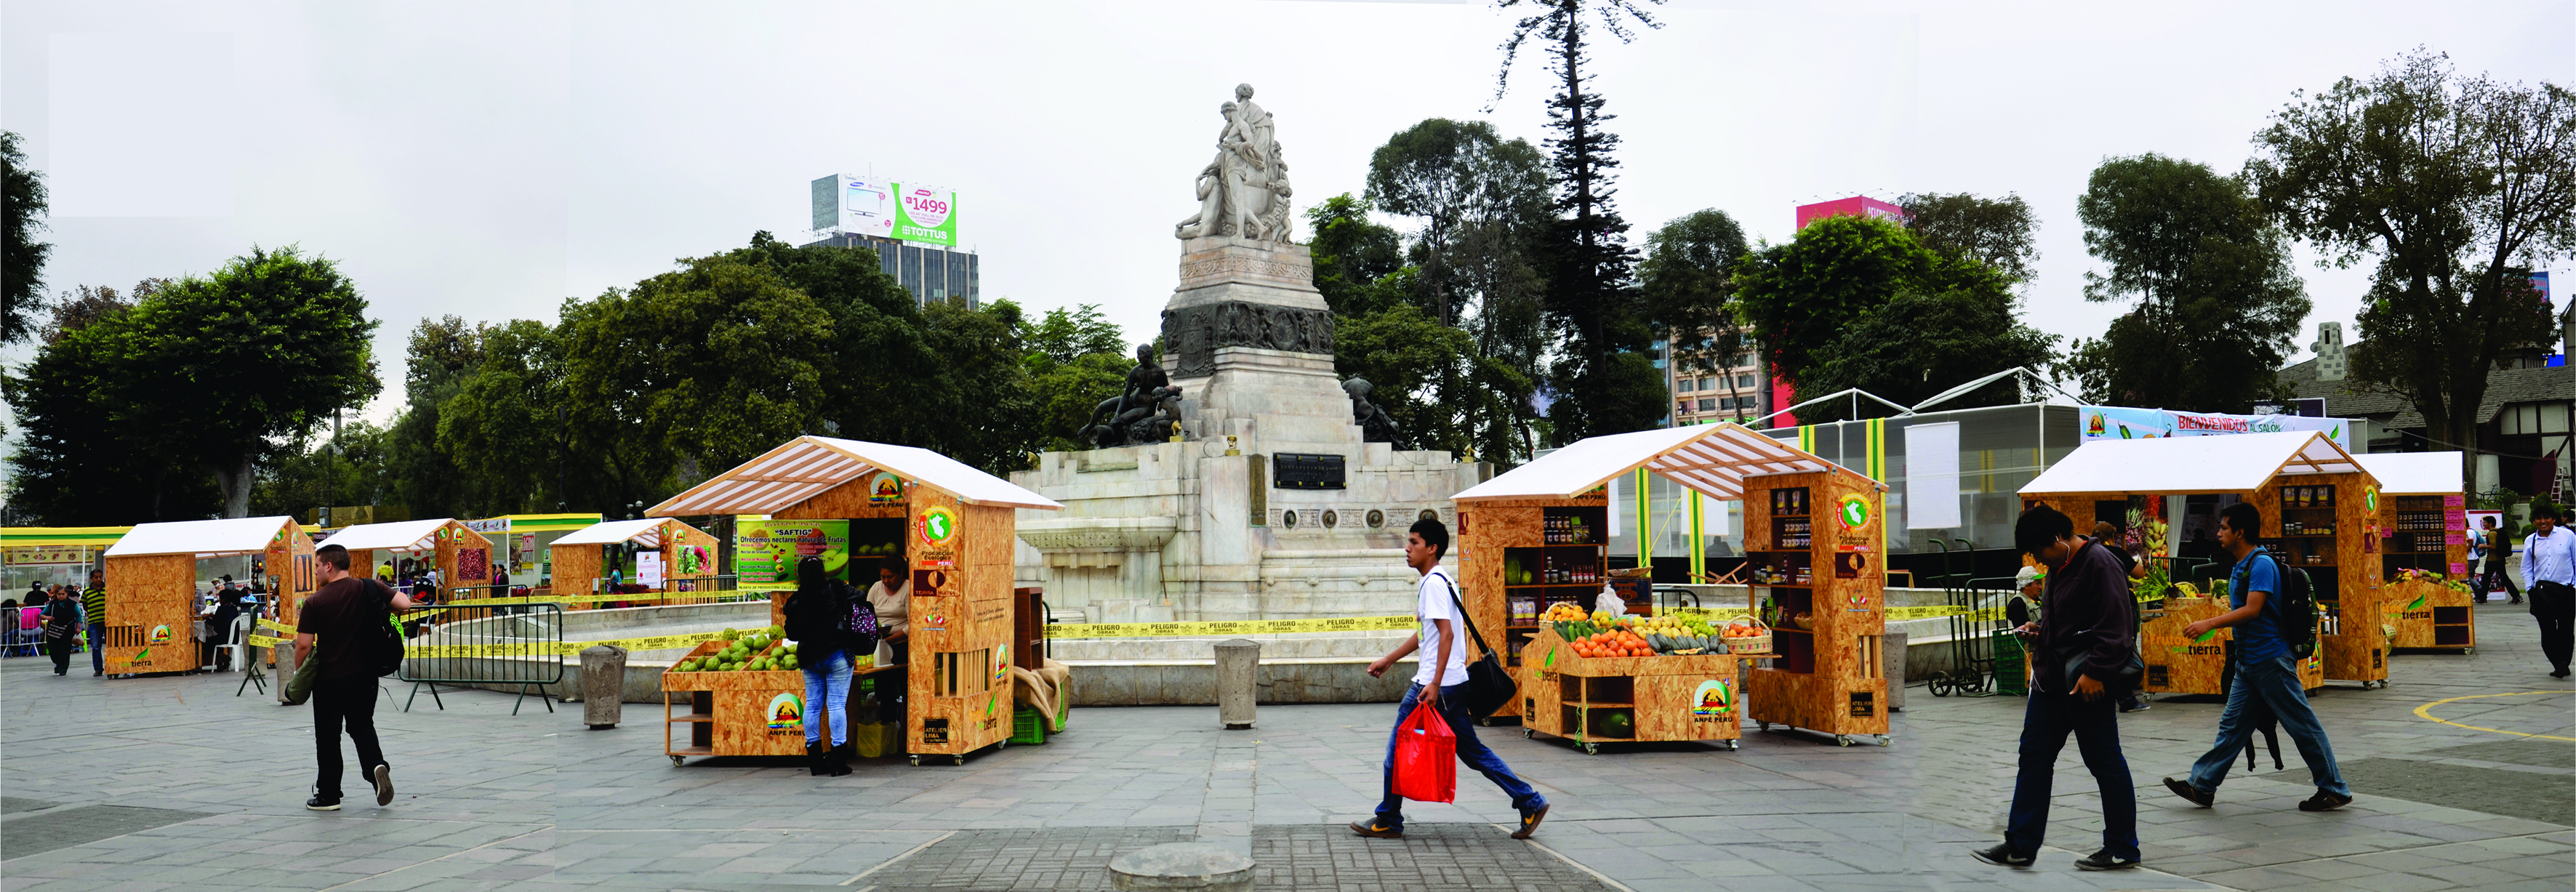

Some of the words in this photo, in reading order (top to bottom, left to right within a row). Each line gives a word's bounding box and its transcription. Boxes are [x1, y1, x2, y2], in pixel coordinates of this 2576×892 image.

[913, 198, 947, 214] 1499
[911, 227, 947, 240] TOTTUS
[2178, 416, 2247, 432] BIENVENIDOS
[2259, 422, 2280, 432] SALÓN
[2150, 634, 2188, 646] Frutos
[2188, 645, 2221, 655] tierra
[1543, 670, 1557, 682] tierra
